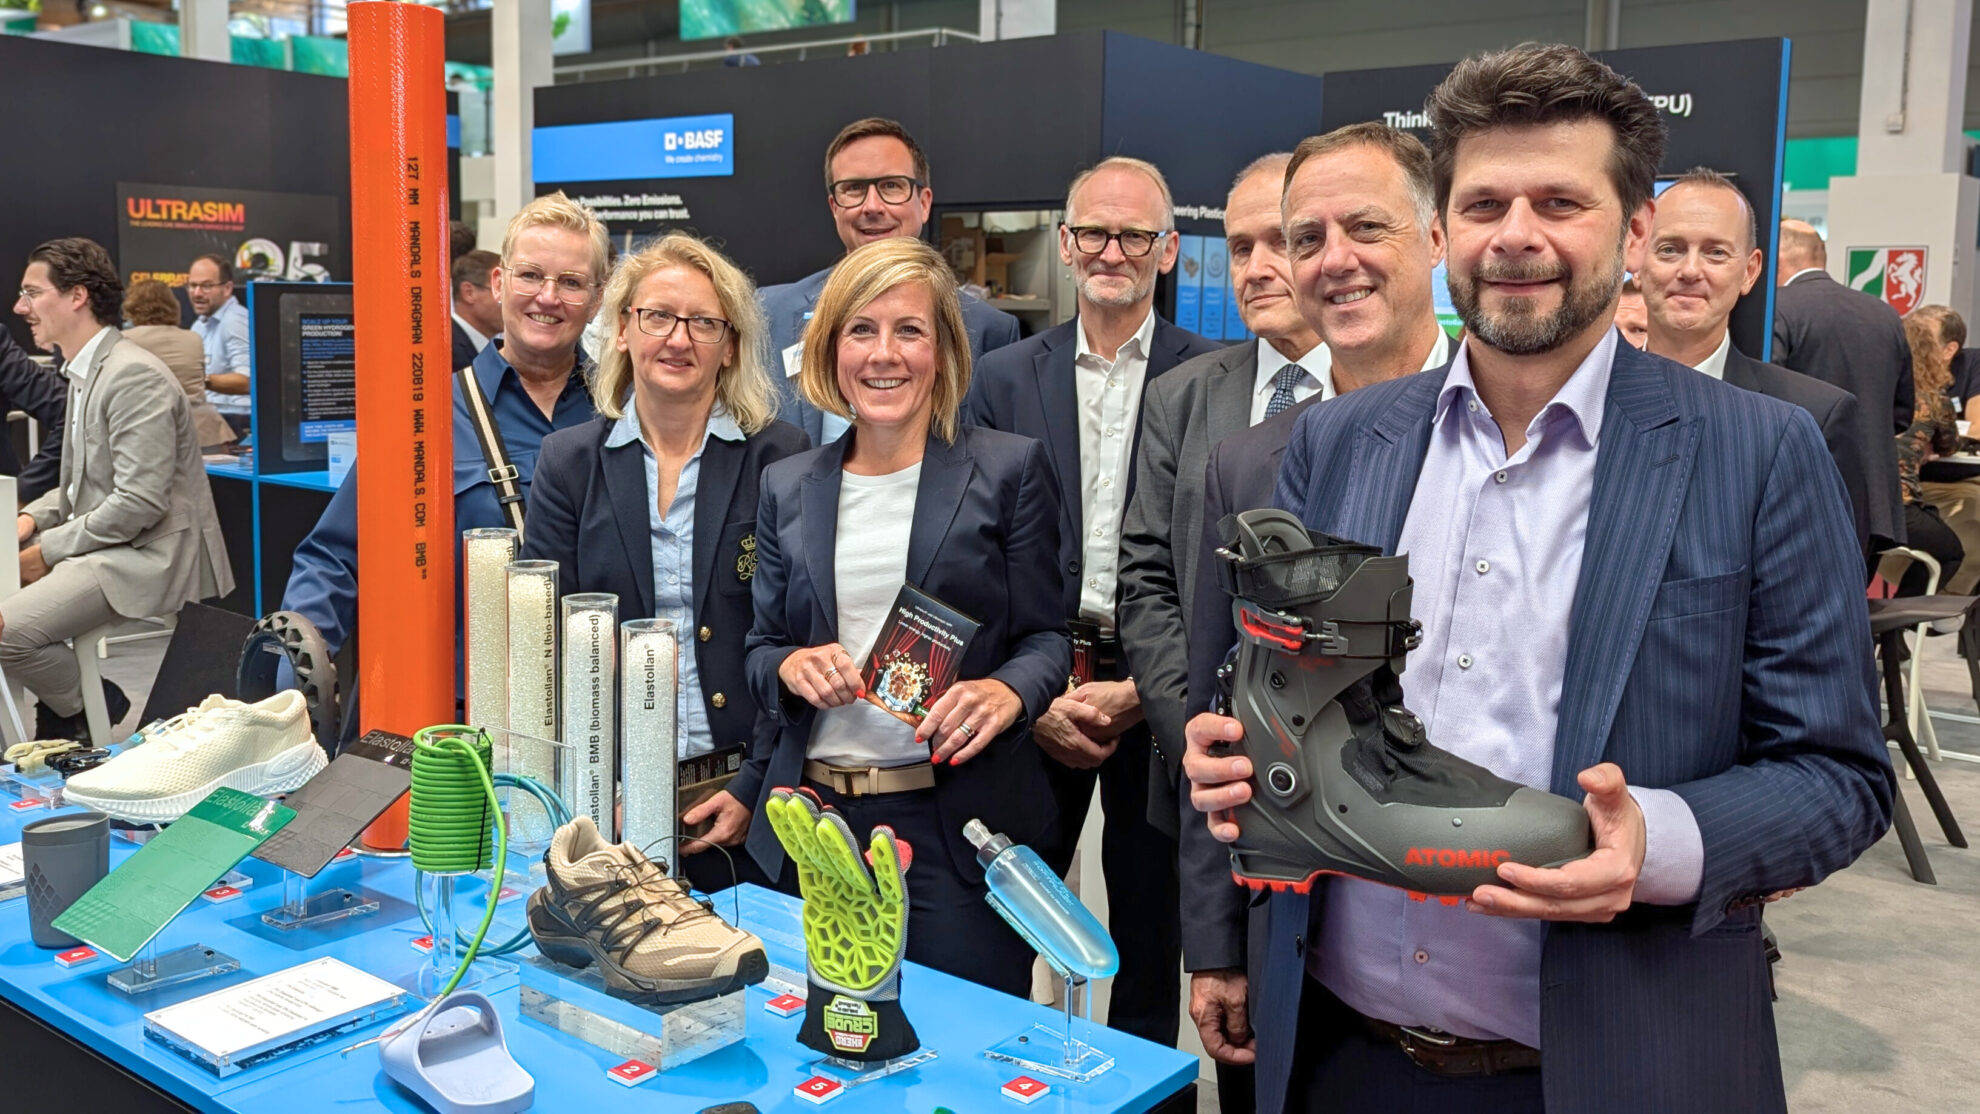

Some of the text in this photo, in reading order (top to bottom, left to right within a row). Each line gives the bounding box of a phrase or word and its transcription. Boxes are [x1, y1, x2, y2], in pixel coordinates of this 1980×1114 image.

[683, 130, 723, 149] BASF
[407, 156, 419, 180] 127
[408, 188, 419, 205] MM
[127, 197, 245, 224] ULTRASIM
[638, 210, 653, 222] you
[654, 210, 668, 219] can
[409, 221, 421, 278] MANDALS
[411, 287, 423, 344] DRAGMAN
[412, 352, 424, 401] 220819
[544, 579, 554, 647] (bio-based)
[898, 606, 913, 619] High
[914, 614, 950, 639] Productivity
[950, 634, 964, 647] Plus
[544, 651, 553, 659] N
[590, 614, 601, 674] balanced)
[590, 676, 601, 731] (biomass
[589, 734, 600, 764] BMB
[1404, 846, 1512, 868] ATOMIC
[622, 1065, 640, 1075] 2
[810, 1081, 829, 1091] 5
[1018, 1082, 1034, 1090] 4
